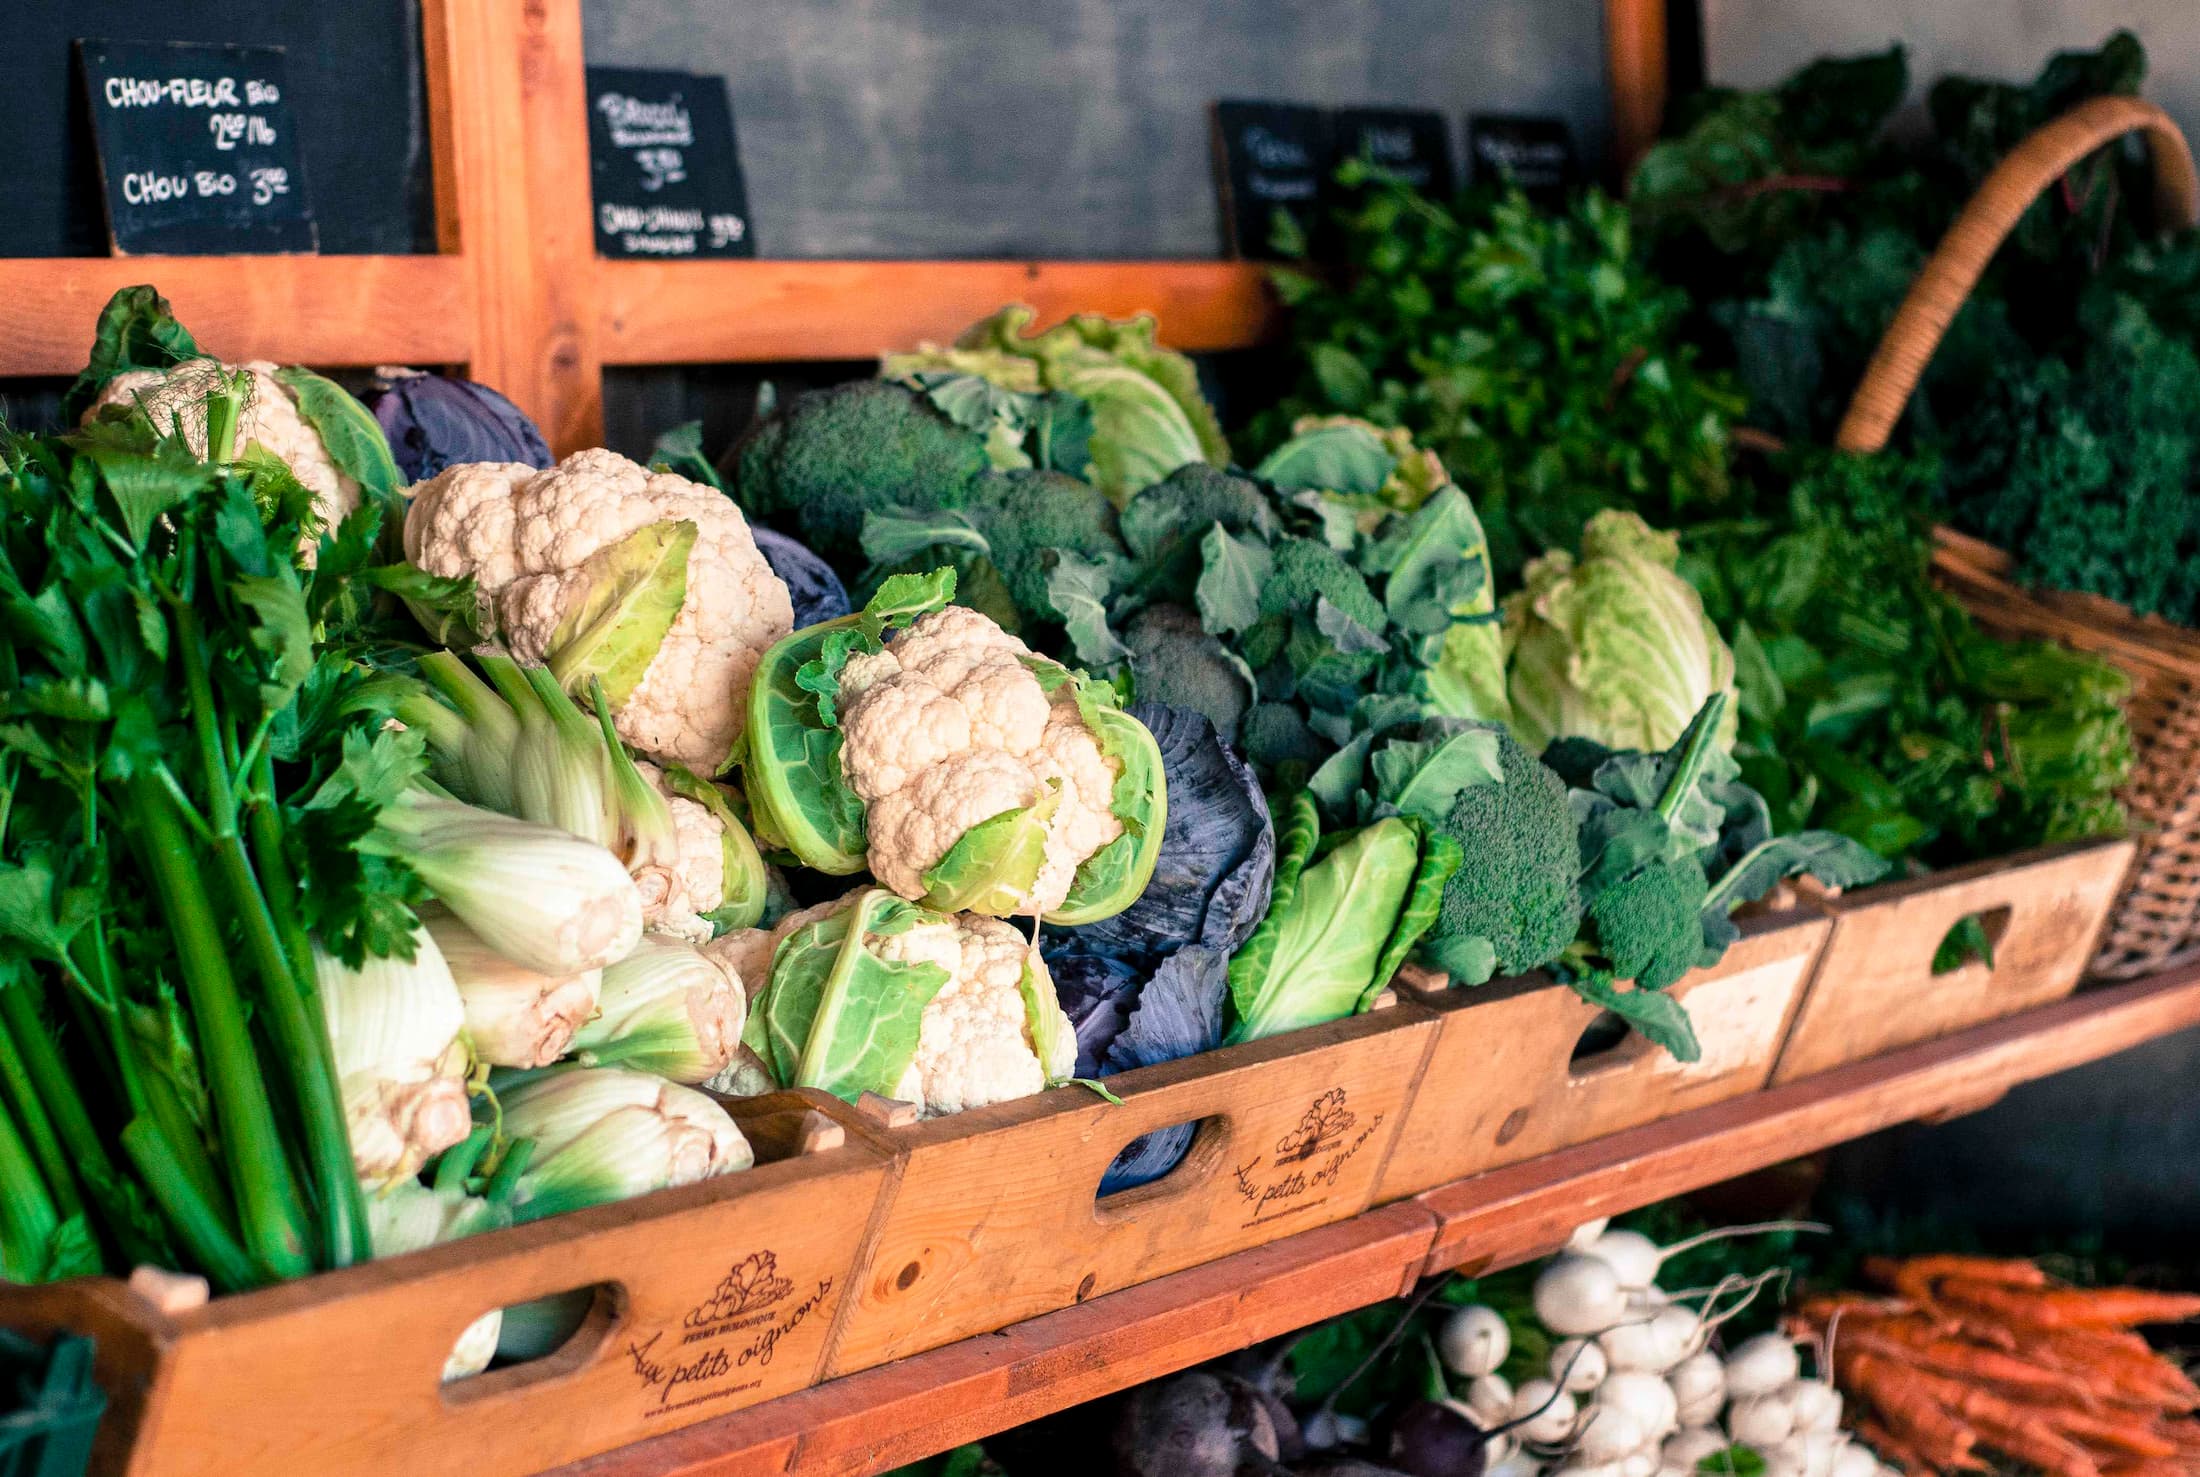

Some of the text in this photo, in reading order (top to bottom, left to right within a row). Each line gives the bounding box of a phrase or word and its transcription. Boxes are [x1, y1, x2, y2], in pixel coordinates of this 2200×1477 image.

[105, 77, 241, 108] CHOU-FLEUR
[123, 171, 188, 205] CHOU
[1254, 1171, 1307, 1217] petits
[660, 1348, 733, 1403] petits
[737, 1275, 833, 1366] oignons
